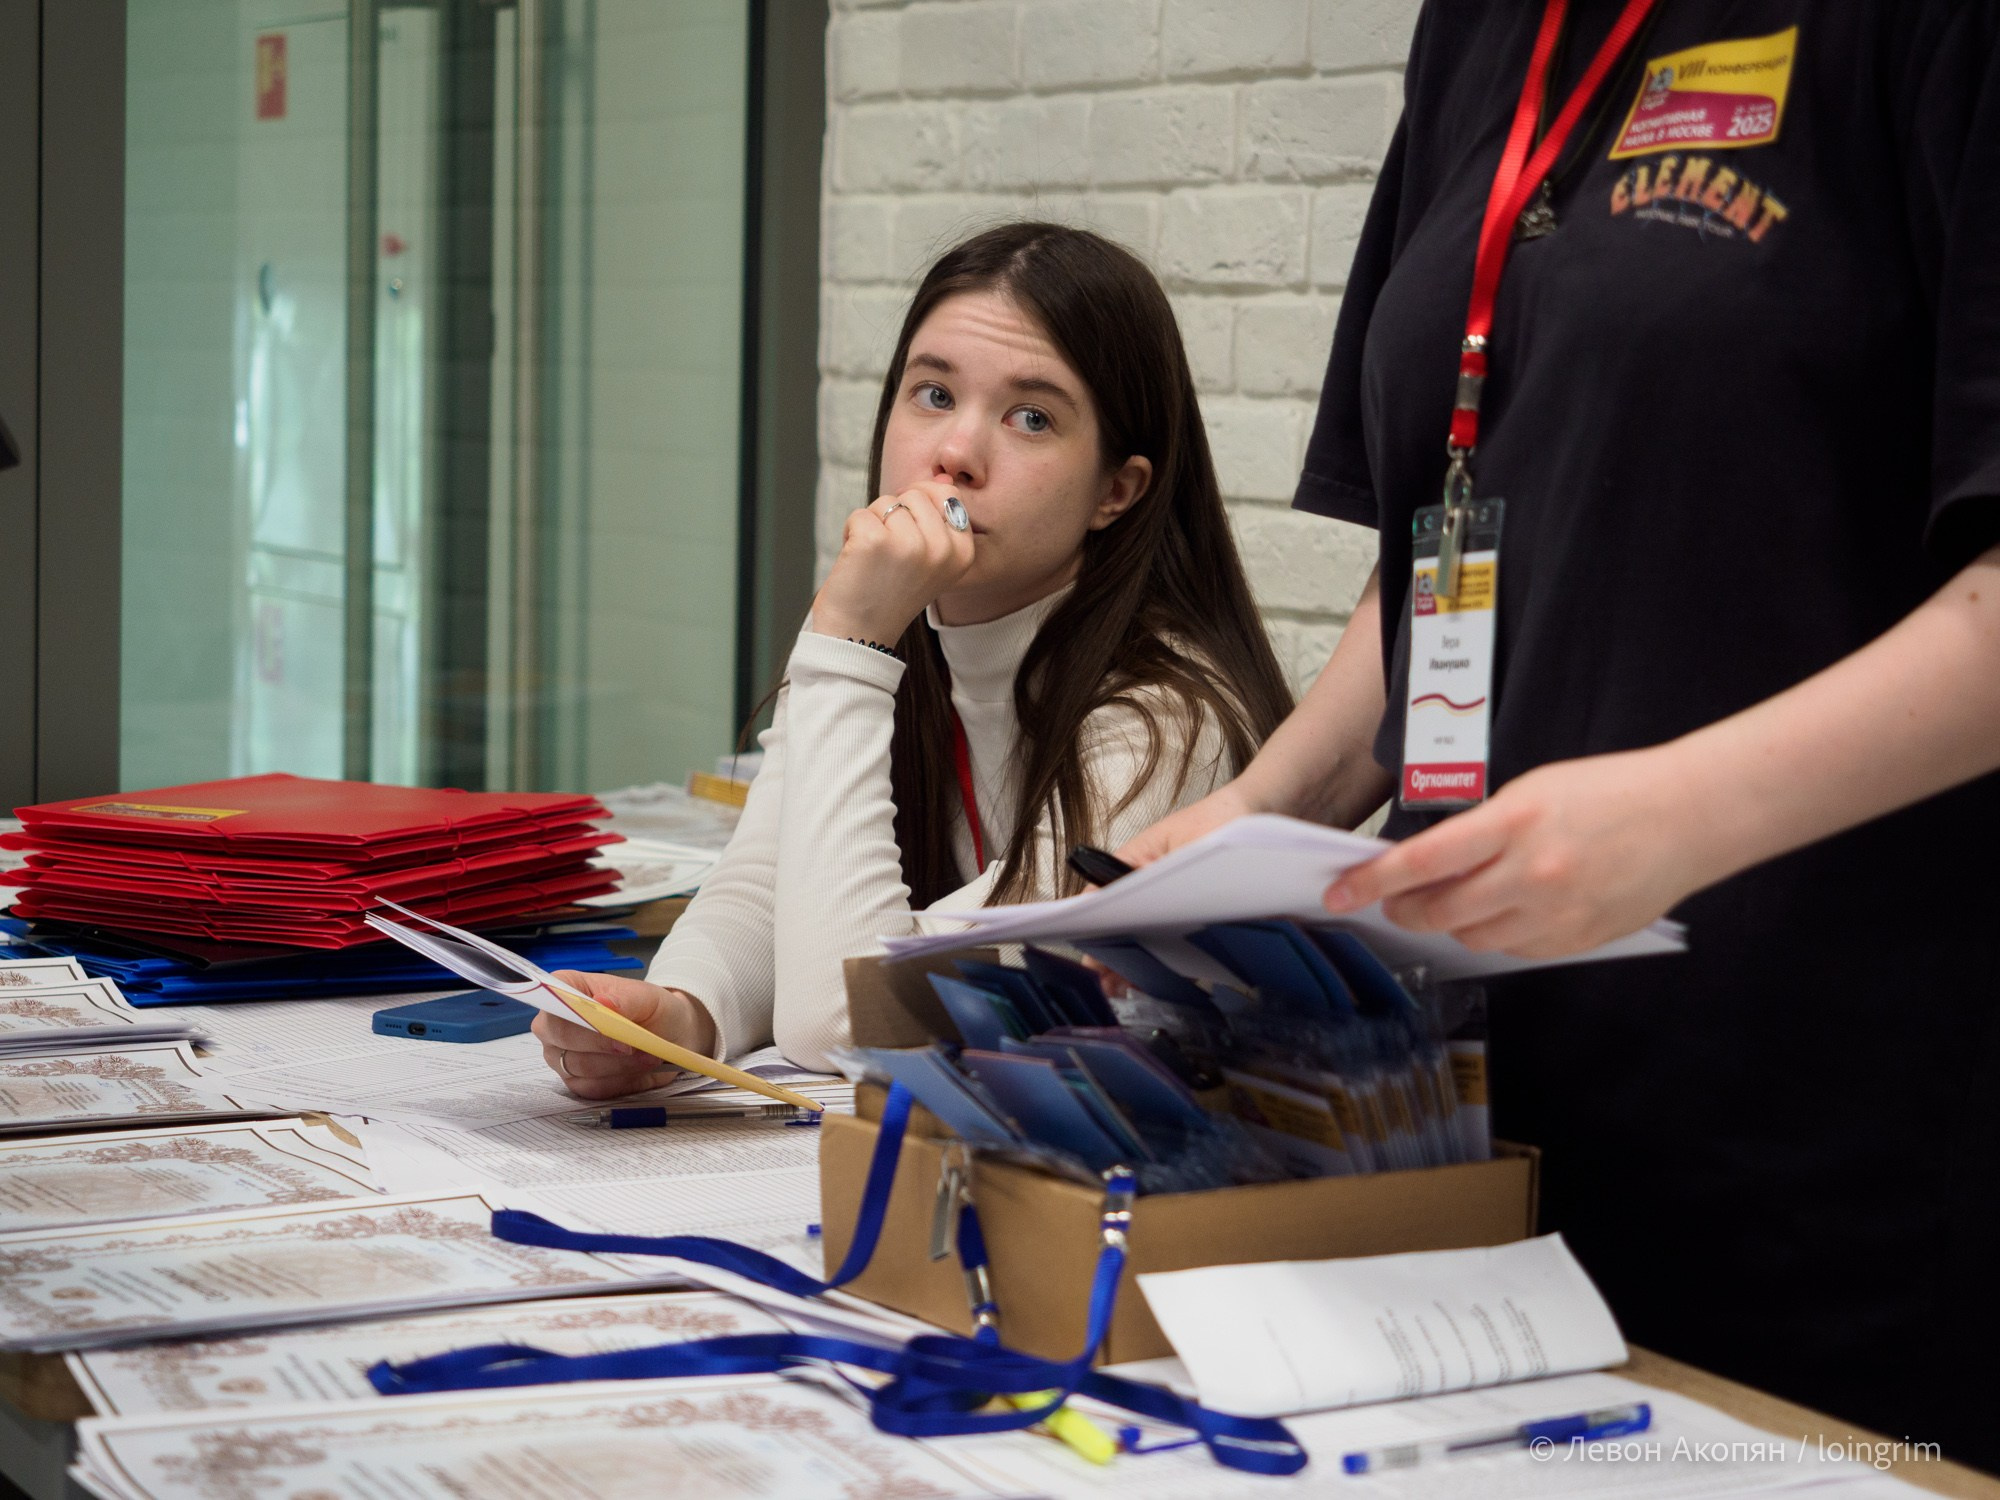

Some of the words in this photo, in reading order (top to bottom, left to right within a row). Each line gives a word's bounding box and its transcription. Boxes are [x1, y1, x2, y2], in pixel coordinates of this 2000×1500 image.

[1727, 112, 1773, 138] 2025
[1610, 156, 1788, 243] ELEMENT
[1411, 769, 1477, 791] Оргкомитет
